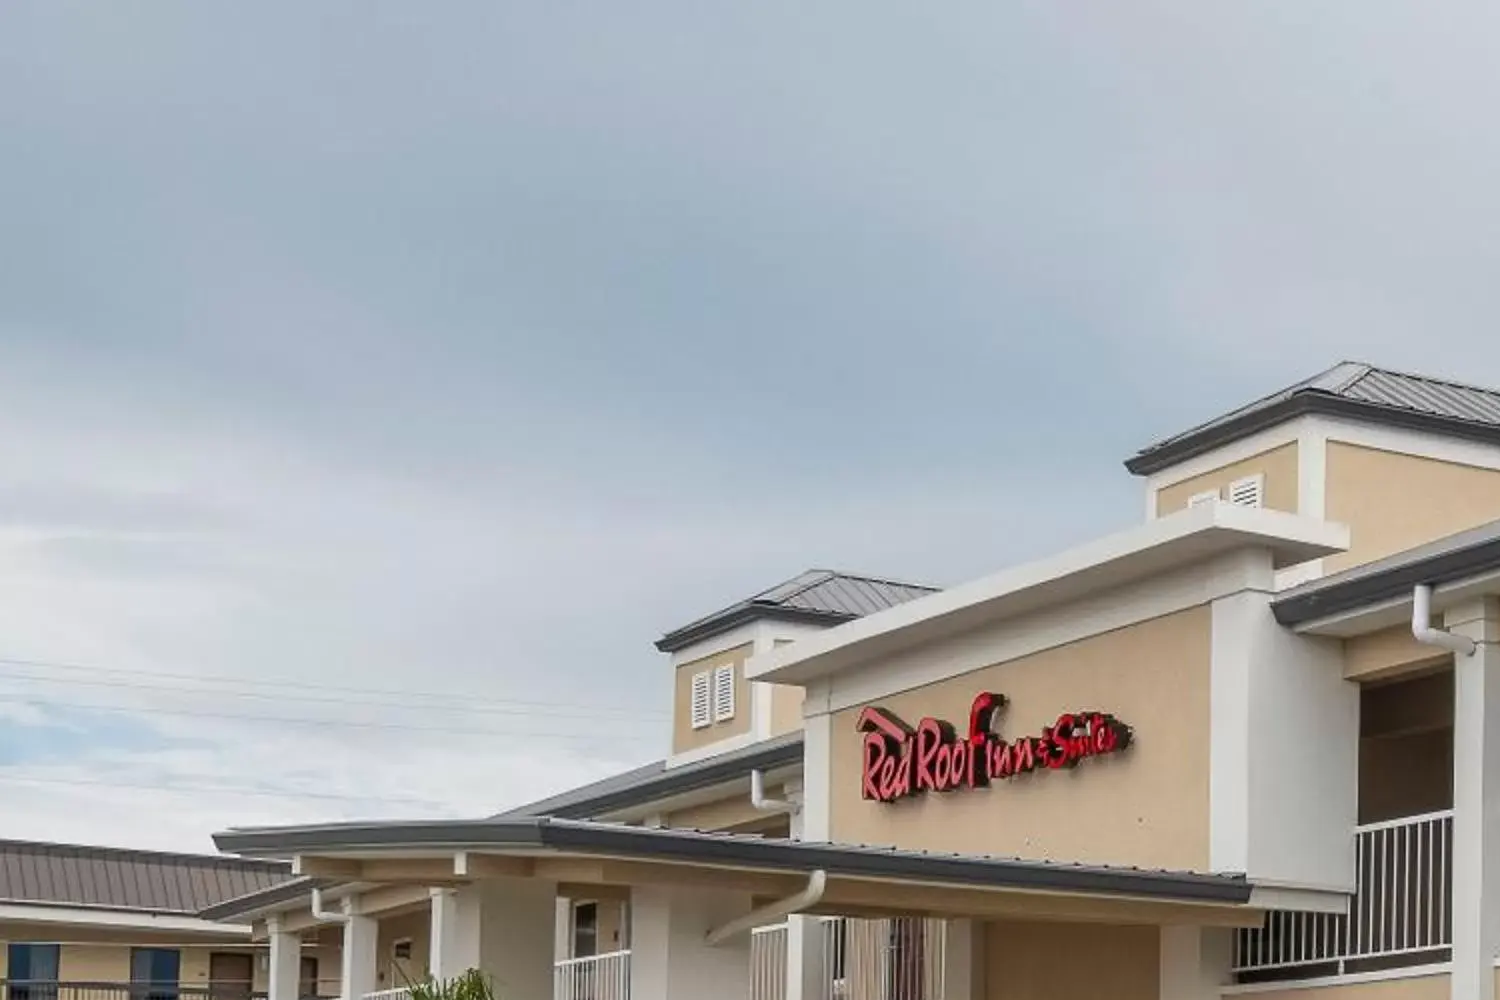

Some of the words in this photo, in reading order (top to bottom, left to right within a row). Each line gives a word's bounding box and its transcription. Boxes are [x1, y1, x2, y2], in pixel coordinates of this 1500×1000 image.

[862, 724, 914, 801] Red
[916, 690, 995, 791] Roof
[984, 736, 1035, 779] Inn
